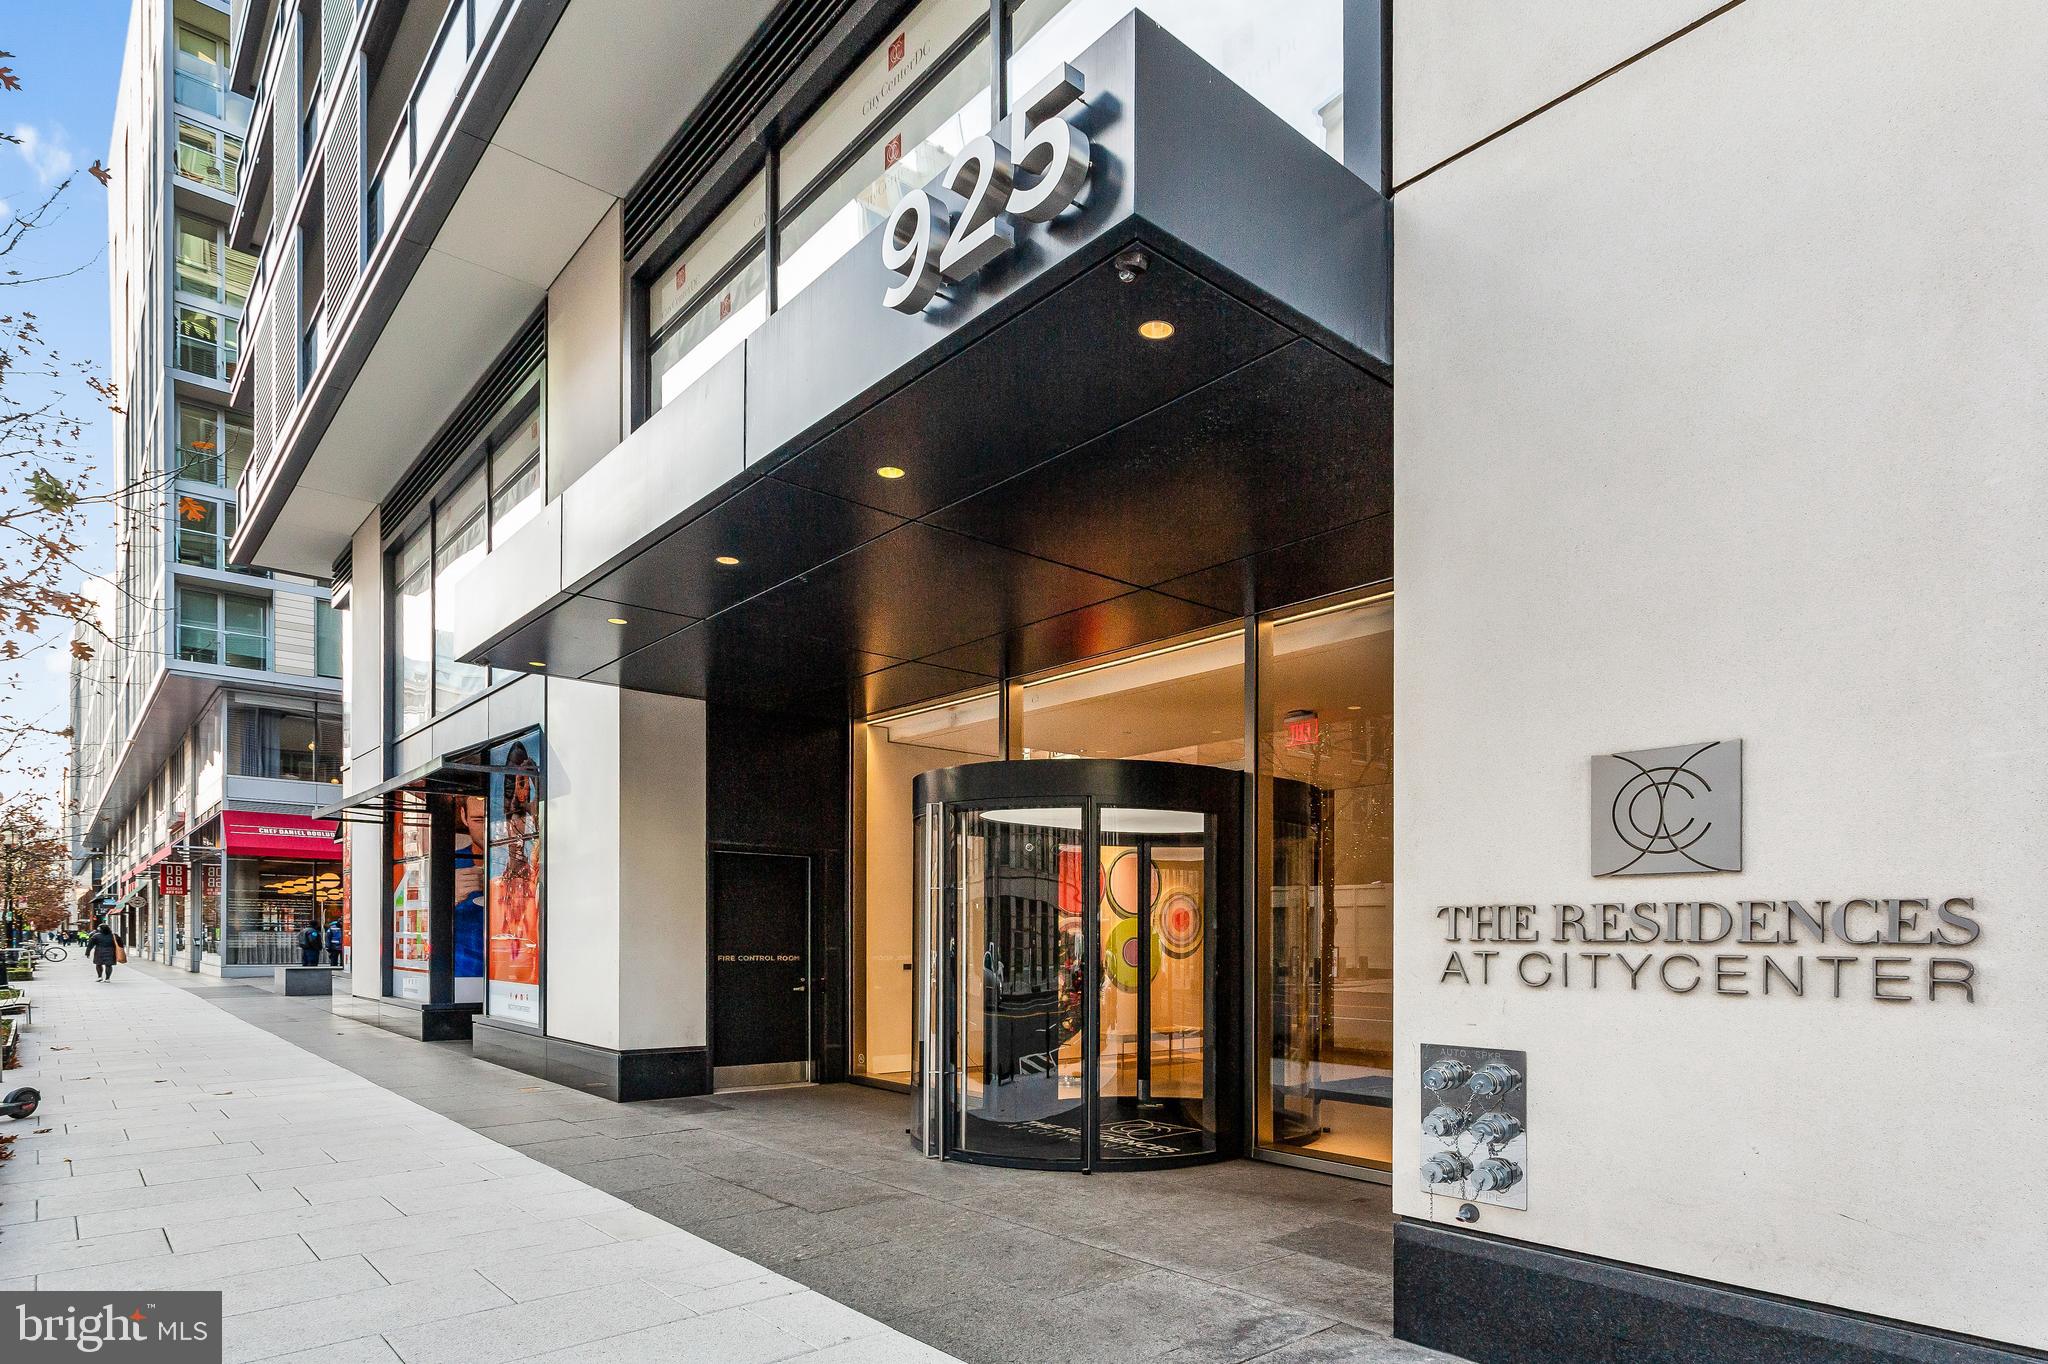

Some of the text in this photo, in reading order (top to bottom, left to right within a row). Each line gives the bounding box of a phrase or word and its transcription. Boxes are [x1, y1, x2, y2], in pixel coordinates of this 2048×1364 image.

[882, 61, 1091, 315] 925
[1436, 896, 1981, 947] THE RESIDENCES
[1440, 950, 1977, 1004] AT CITYCENTER
